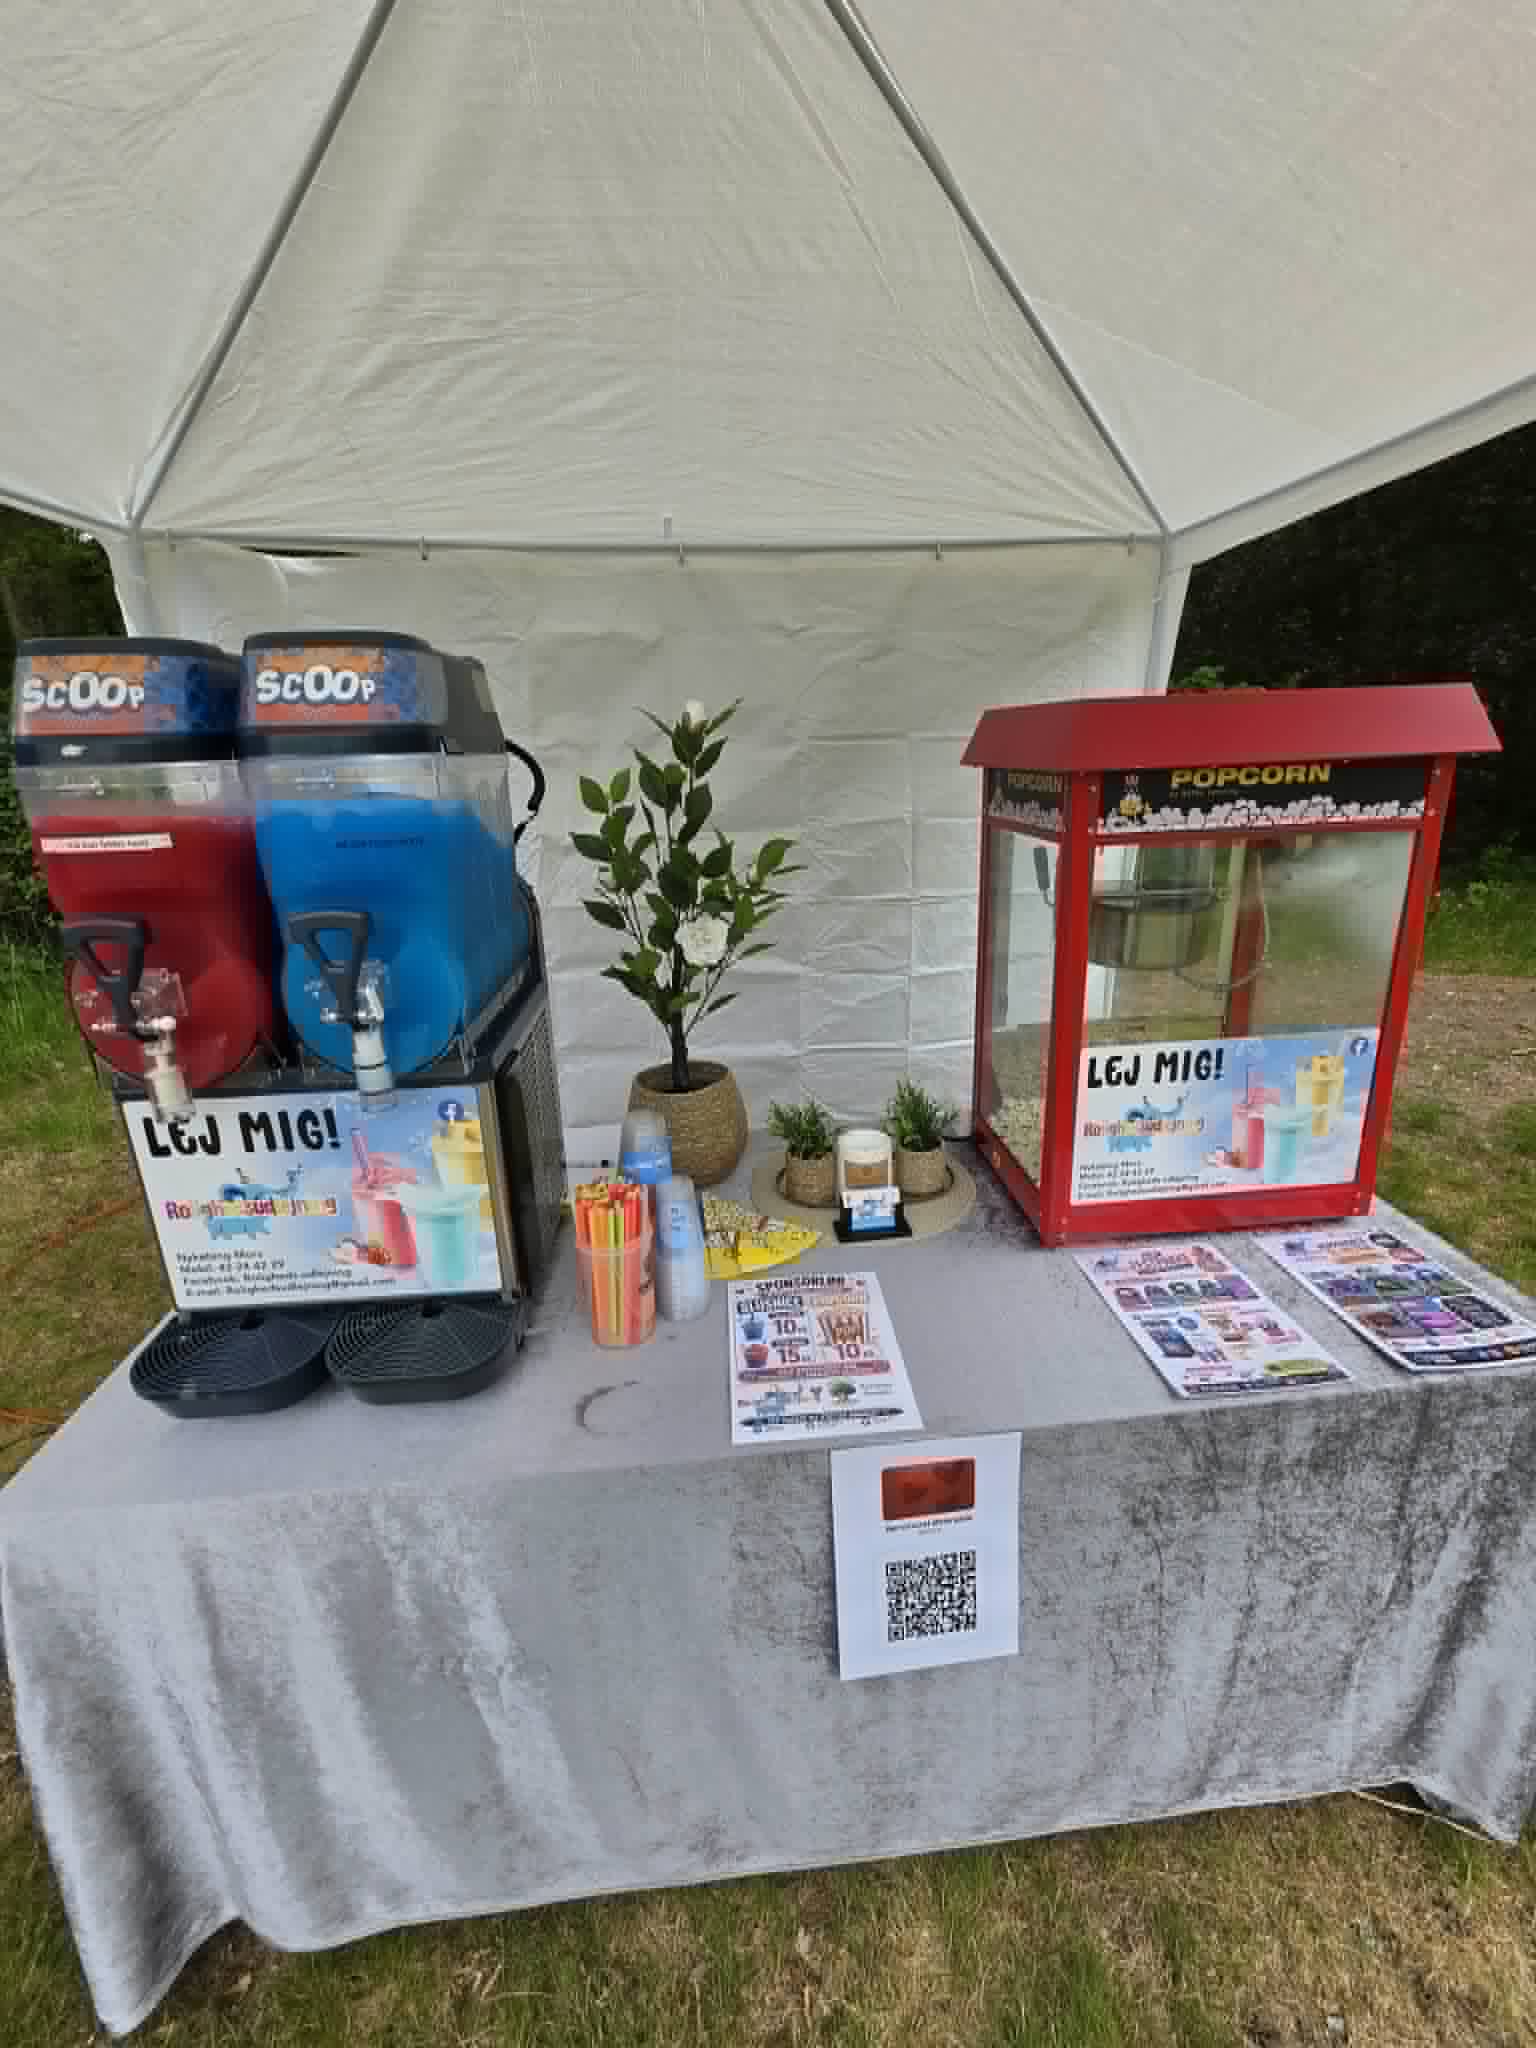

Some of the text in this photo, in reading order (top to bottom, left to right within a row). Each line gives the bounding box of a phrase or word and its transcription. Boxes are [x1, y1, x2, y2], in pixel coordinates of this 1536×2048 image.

[1170, 763, 1331, 789] POPCORN
[1087, 1047, 1225, 1089] LEJ MIG!
[143, 1107, 342, 1158] LEJ MIG!
